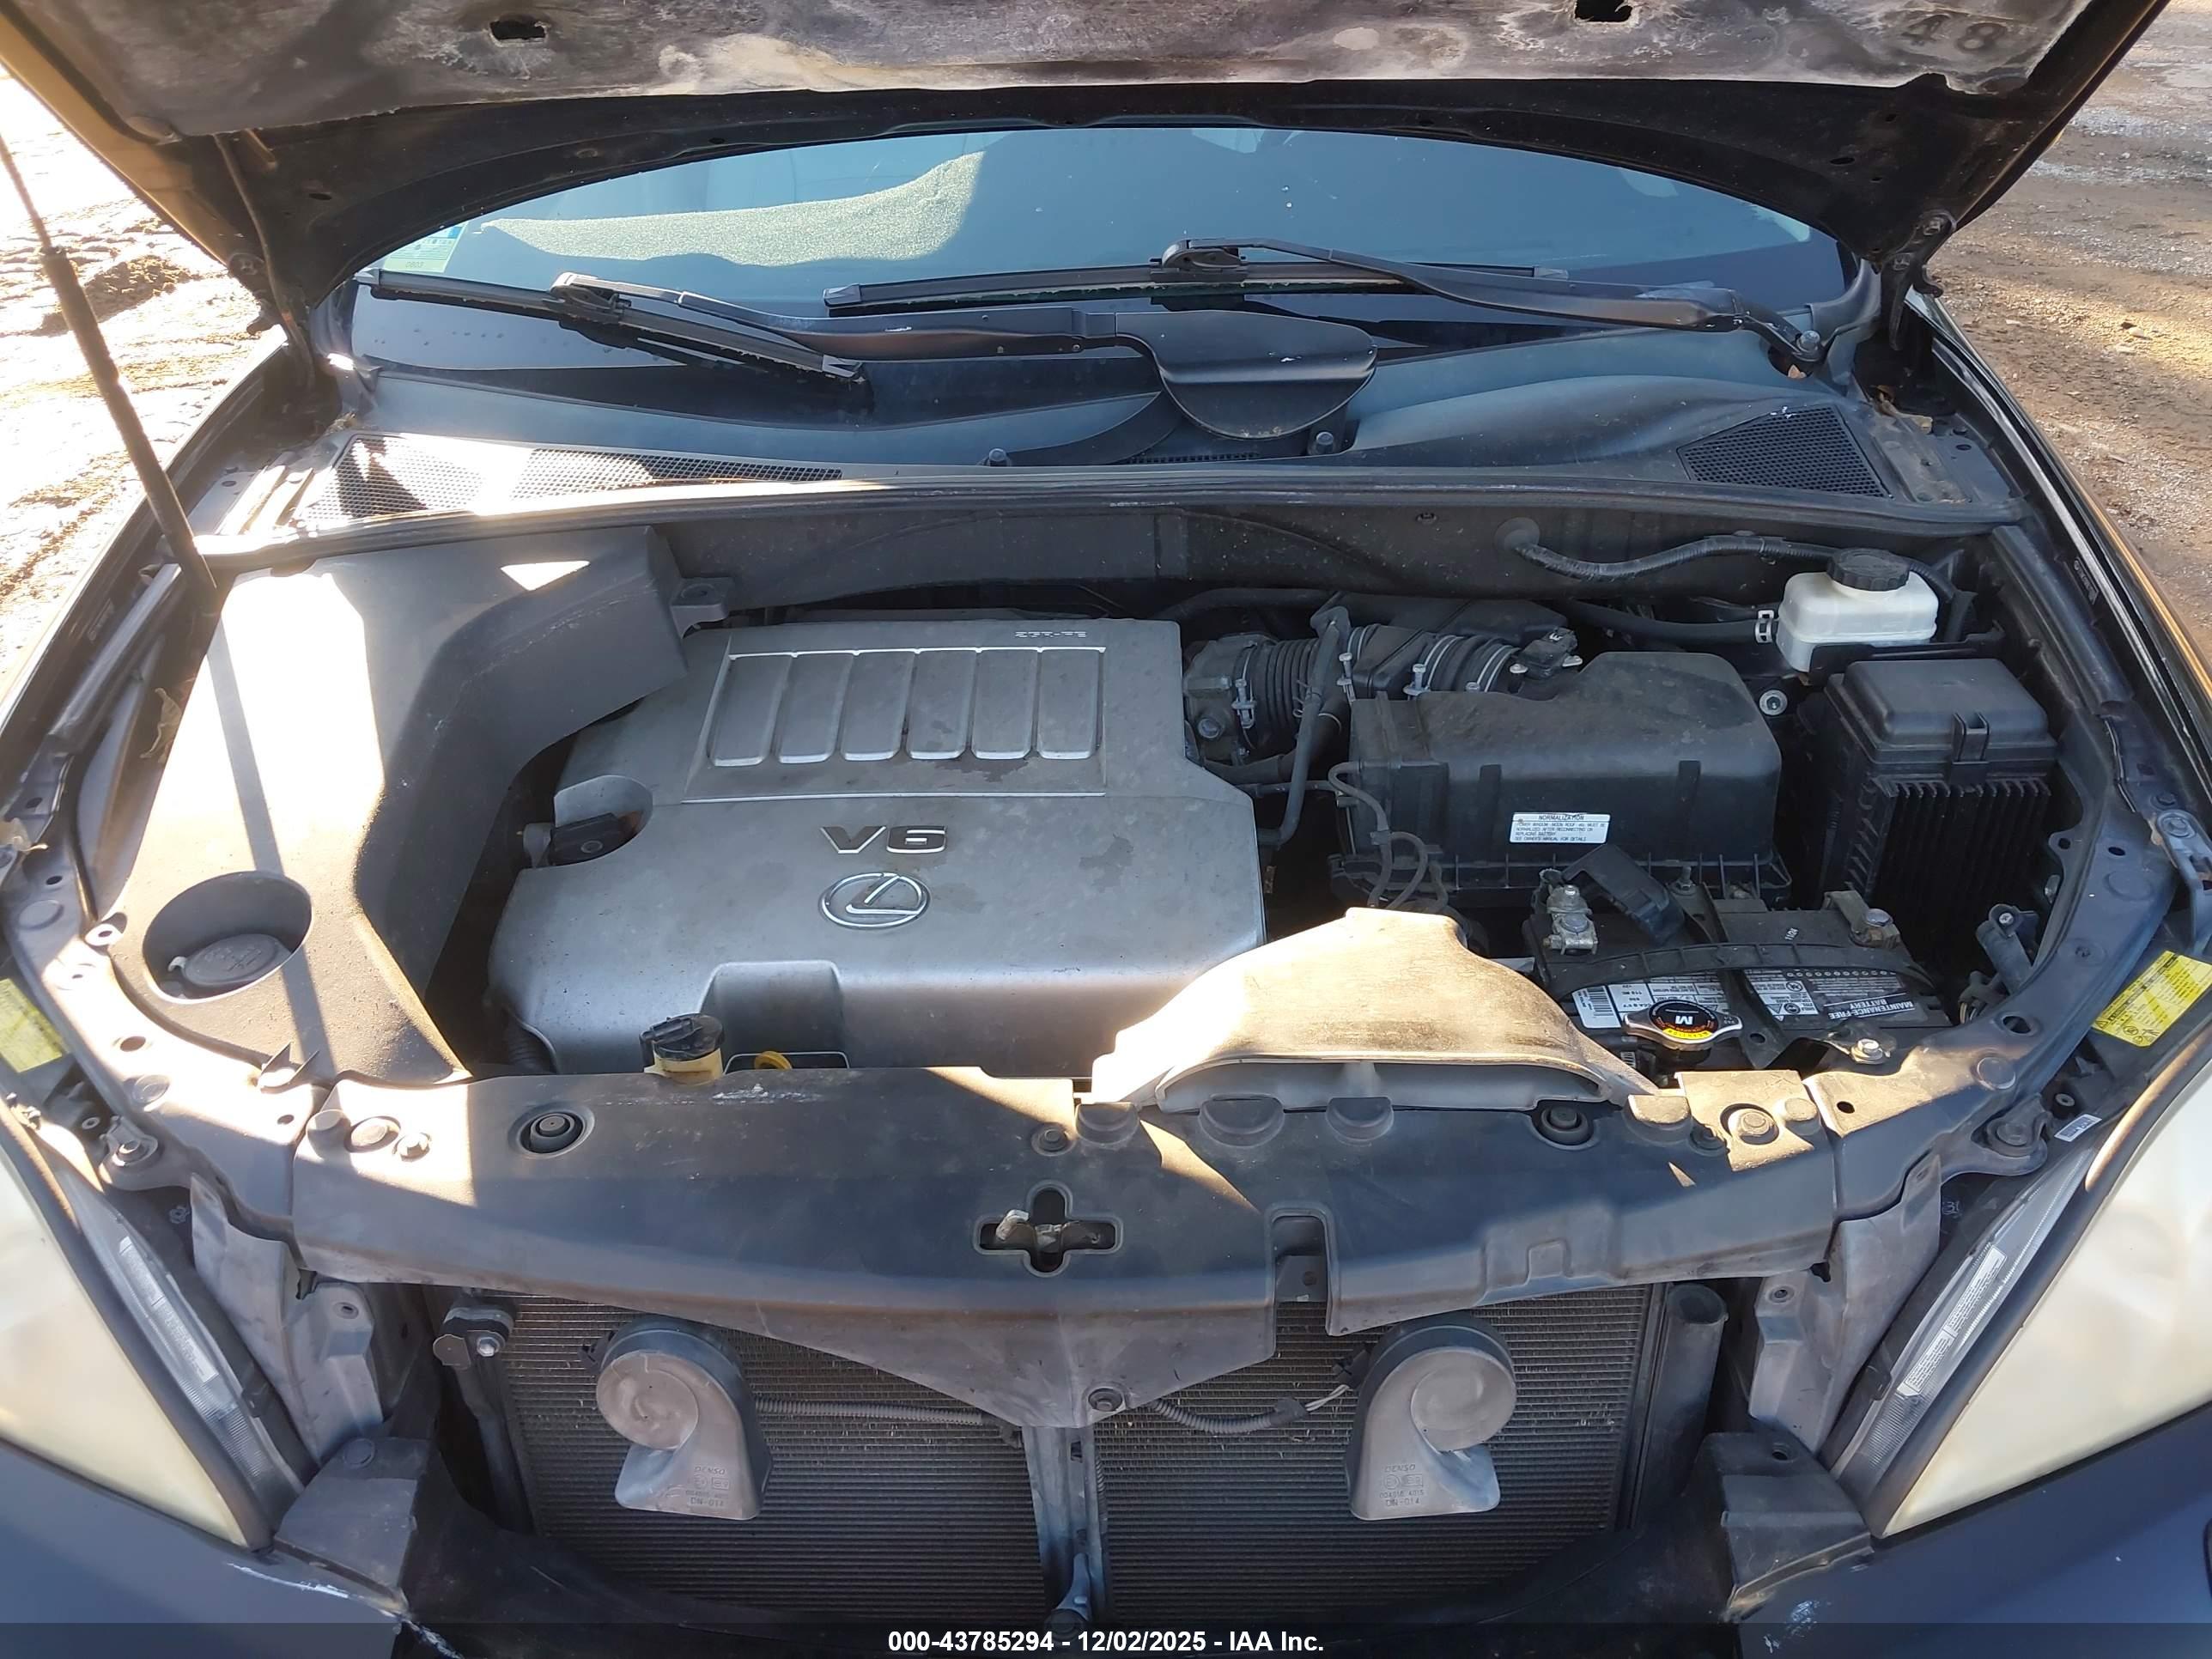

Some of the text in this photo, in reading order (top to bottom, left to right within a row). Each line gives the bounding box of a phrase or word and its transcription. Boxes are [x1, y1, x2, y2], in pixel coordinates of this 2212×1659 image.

[820, 825, 947, 854] V6
[1850, 999, 1887, 1010] BATTERY
[1827, 1001, 1915, 1020] MAINTENANCE-FREE
[1675, 1015, 1693, 1025] M
[1384, 1463, 1416, 1473] DENSO
